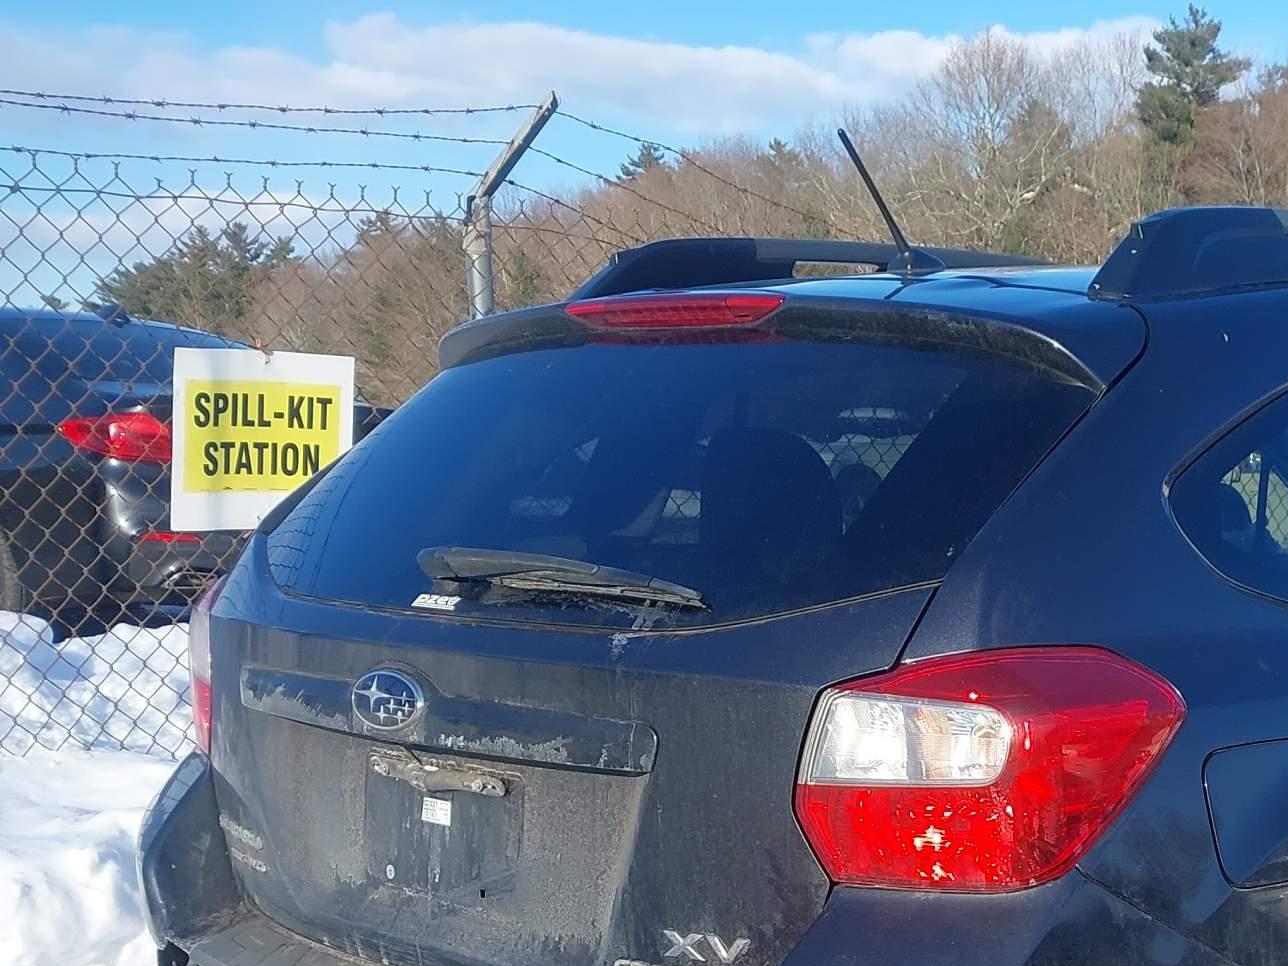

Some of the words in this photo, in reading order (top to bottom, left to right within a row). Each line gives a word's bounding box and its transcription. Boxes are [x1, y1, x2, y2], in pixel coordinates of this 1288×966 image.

[193, 391, 333, 431] SPILL-KIT
[202, 440, 321, 477] STATION
[663, 929, 751, 964] XV
